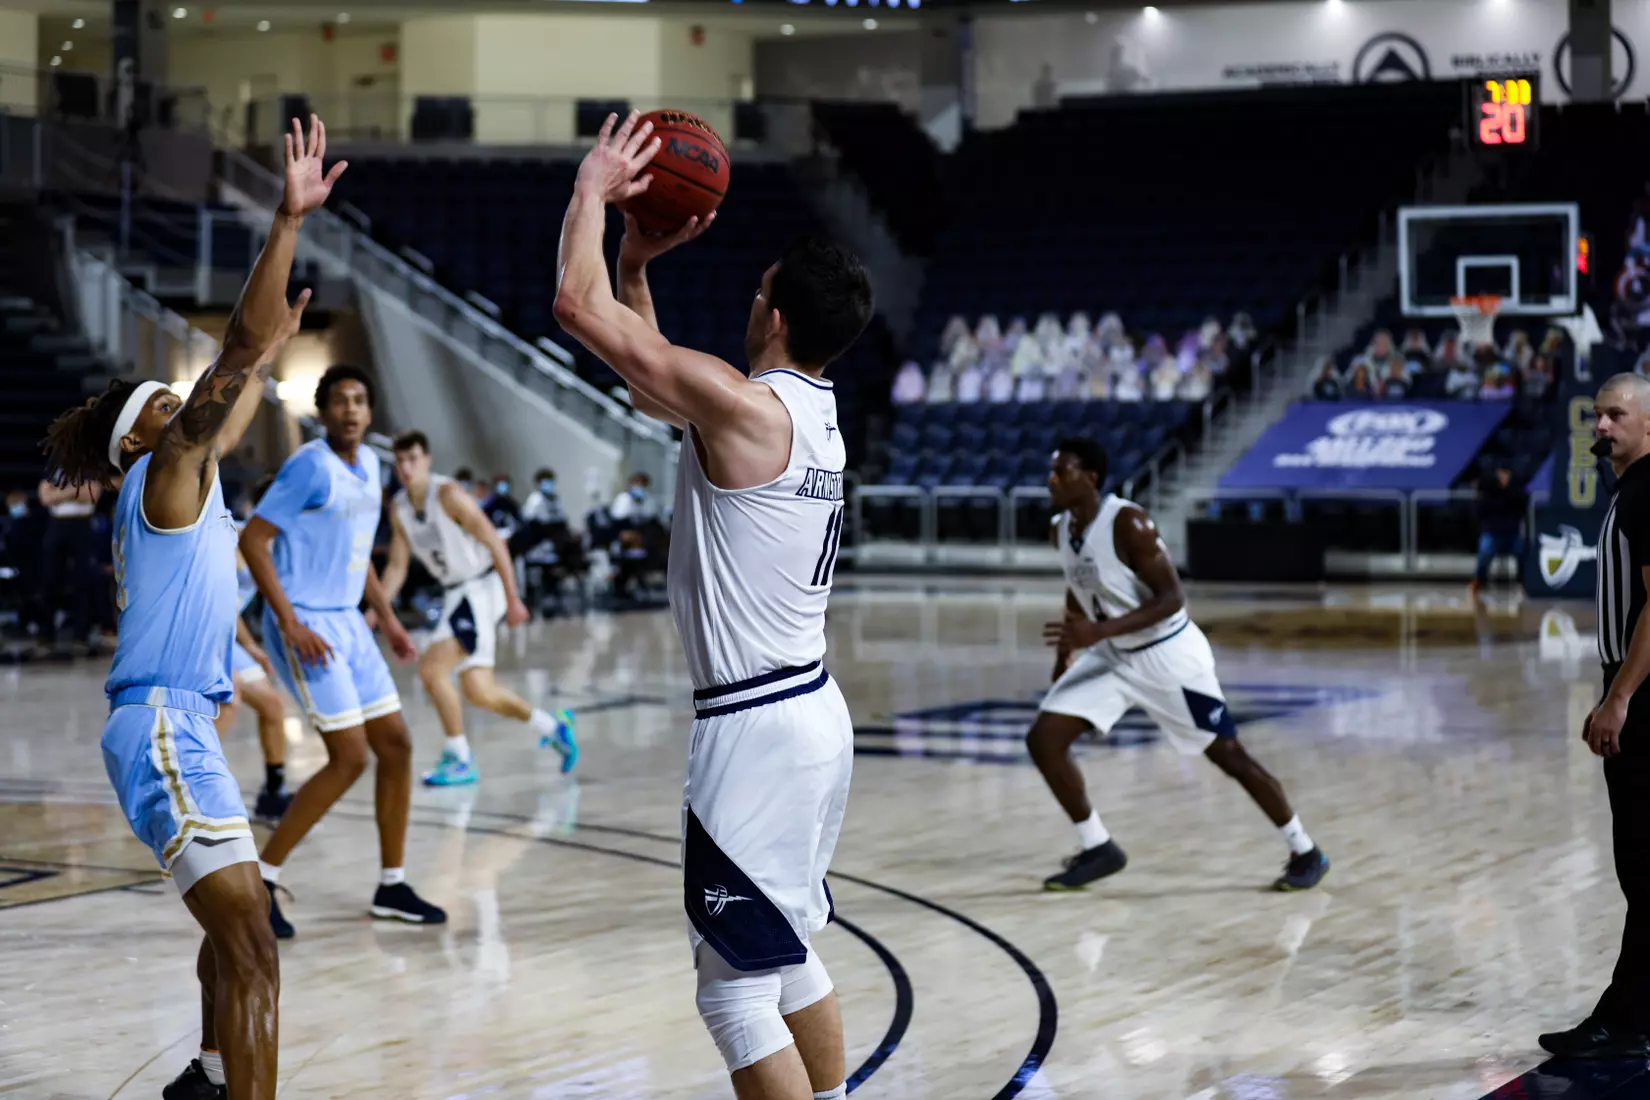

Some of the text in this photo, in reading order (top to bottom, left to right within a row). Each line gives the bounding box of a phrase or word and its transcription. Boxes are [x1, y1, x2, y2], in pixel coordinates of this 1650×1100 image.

[1480, 102, 1526, 145] 20
[665, 136, 720, 176] NCAA
[1568, 395, 1598, 507] CBU
[810, 504, 845, 586] 11
